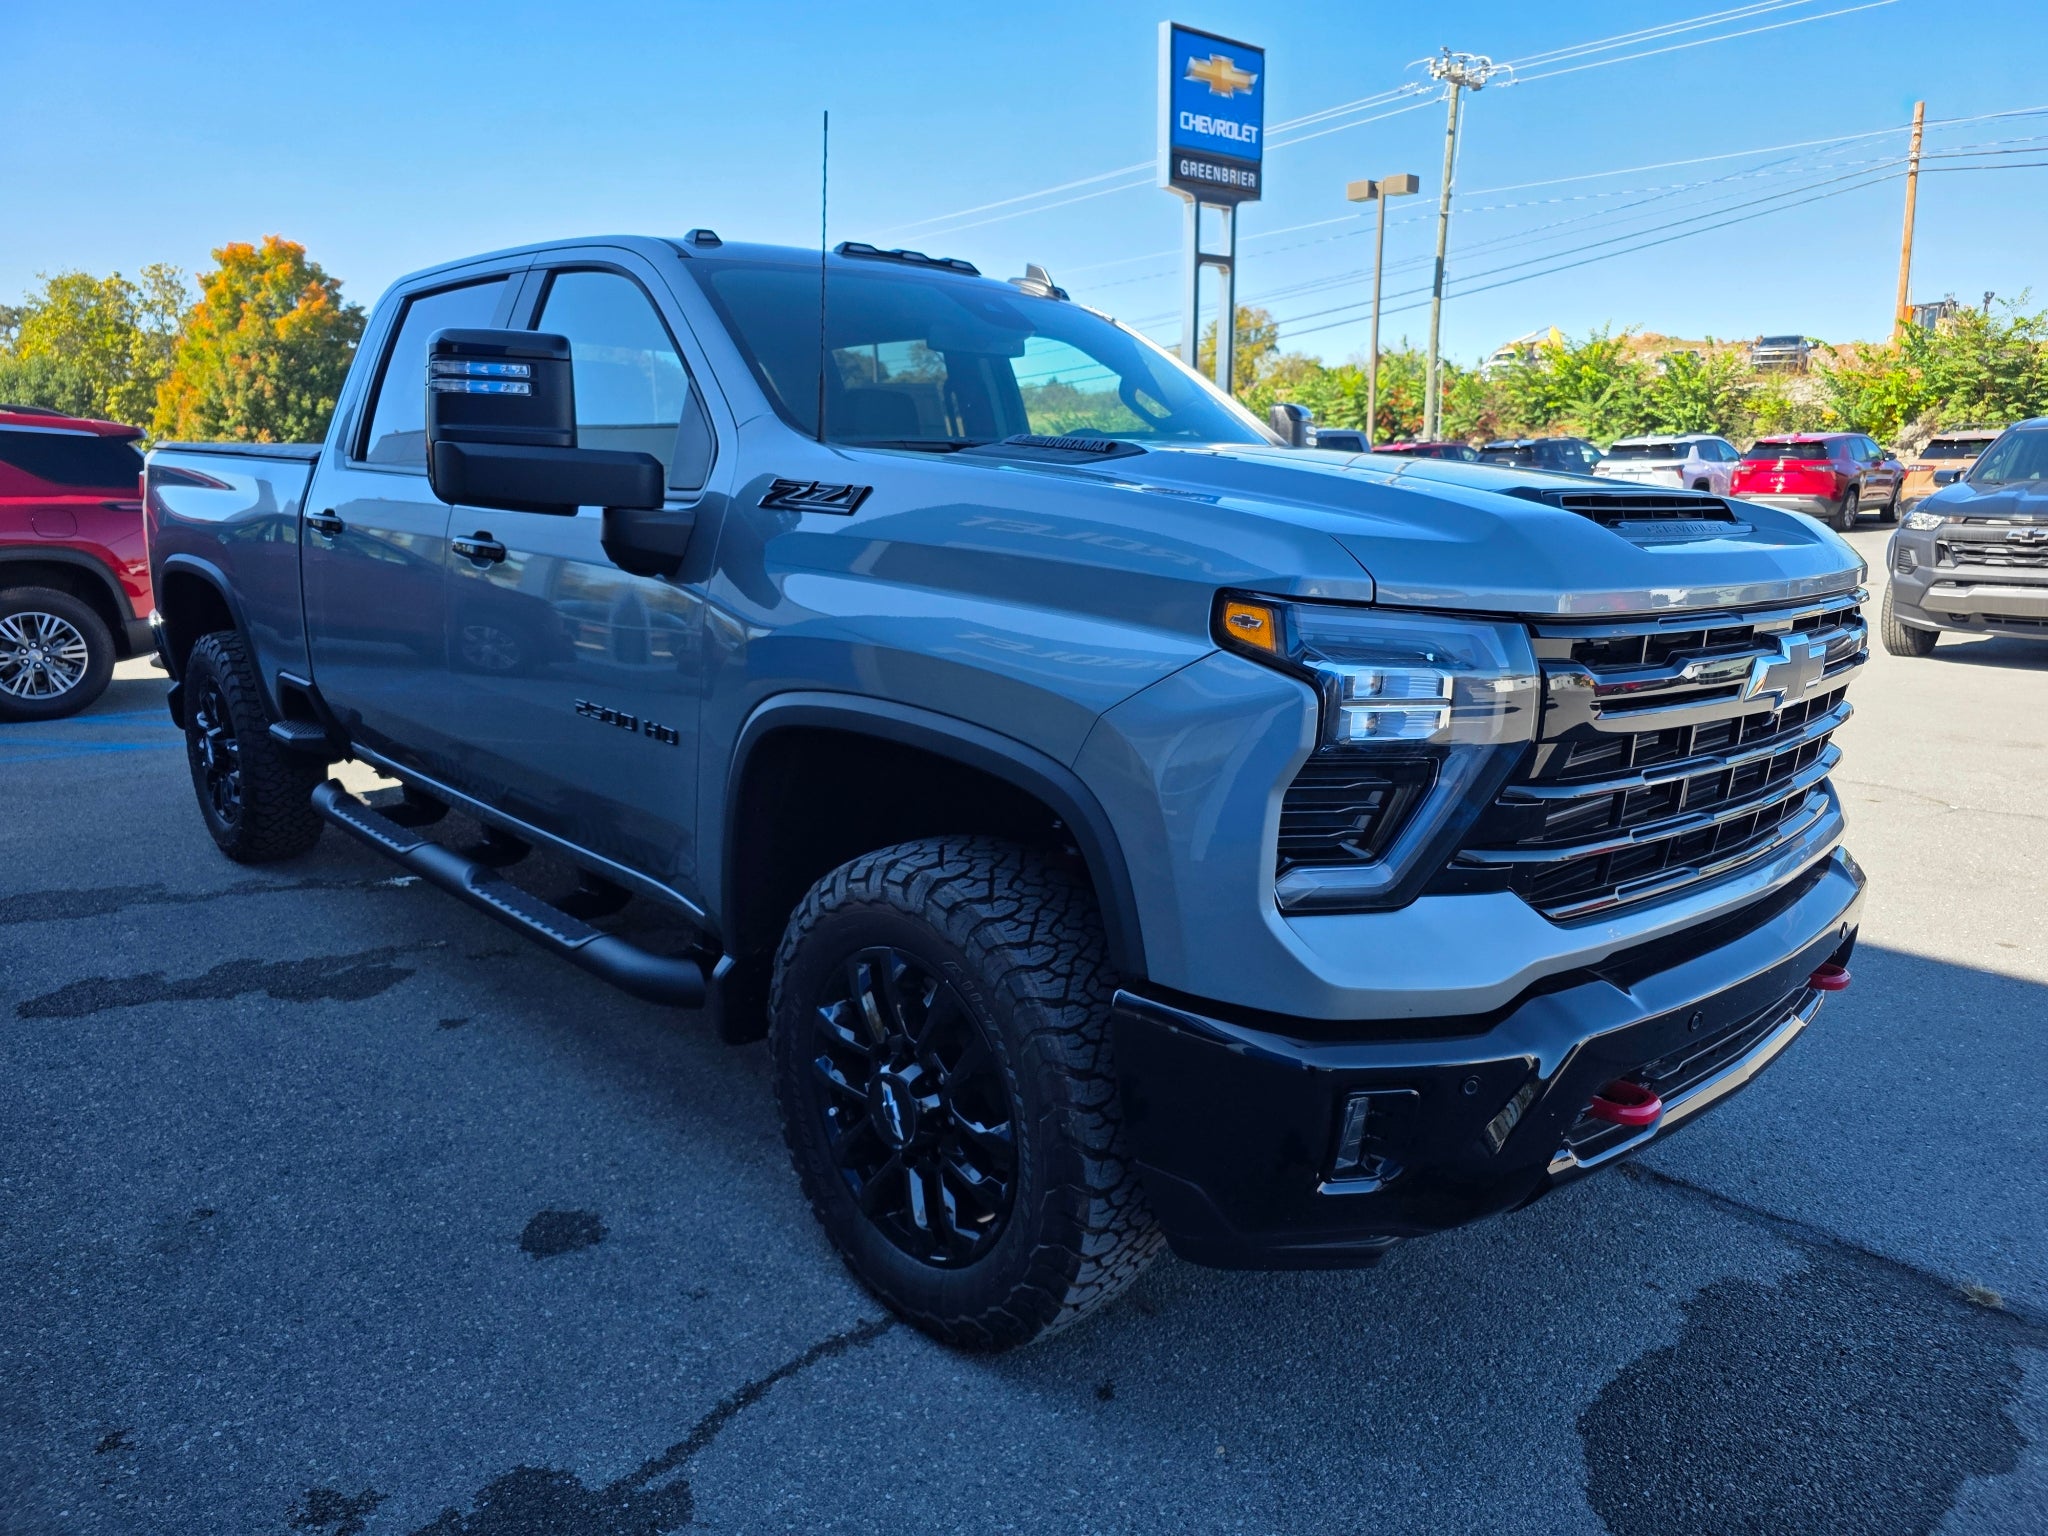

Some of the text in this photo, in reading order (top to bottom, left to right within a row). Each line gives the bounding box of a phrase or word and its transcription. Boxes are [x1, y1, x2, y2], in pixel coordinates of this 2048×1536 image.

[1180, 111, 1258, 143] CHEVROLET
[1180, 159, 1256, 188] GREENBRIER
[757, 478, 873, 516] Z71
[575, 698, 680, 746] 2500 HD
